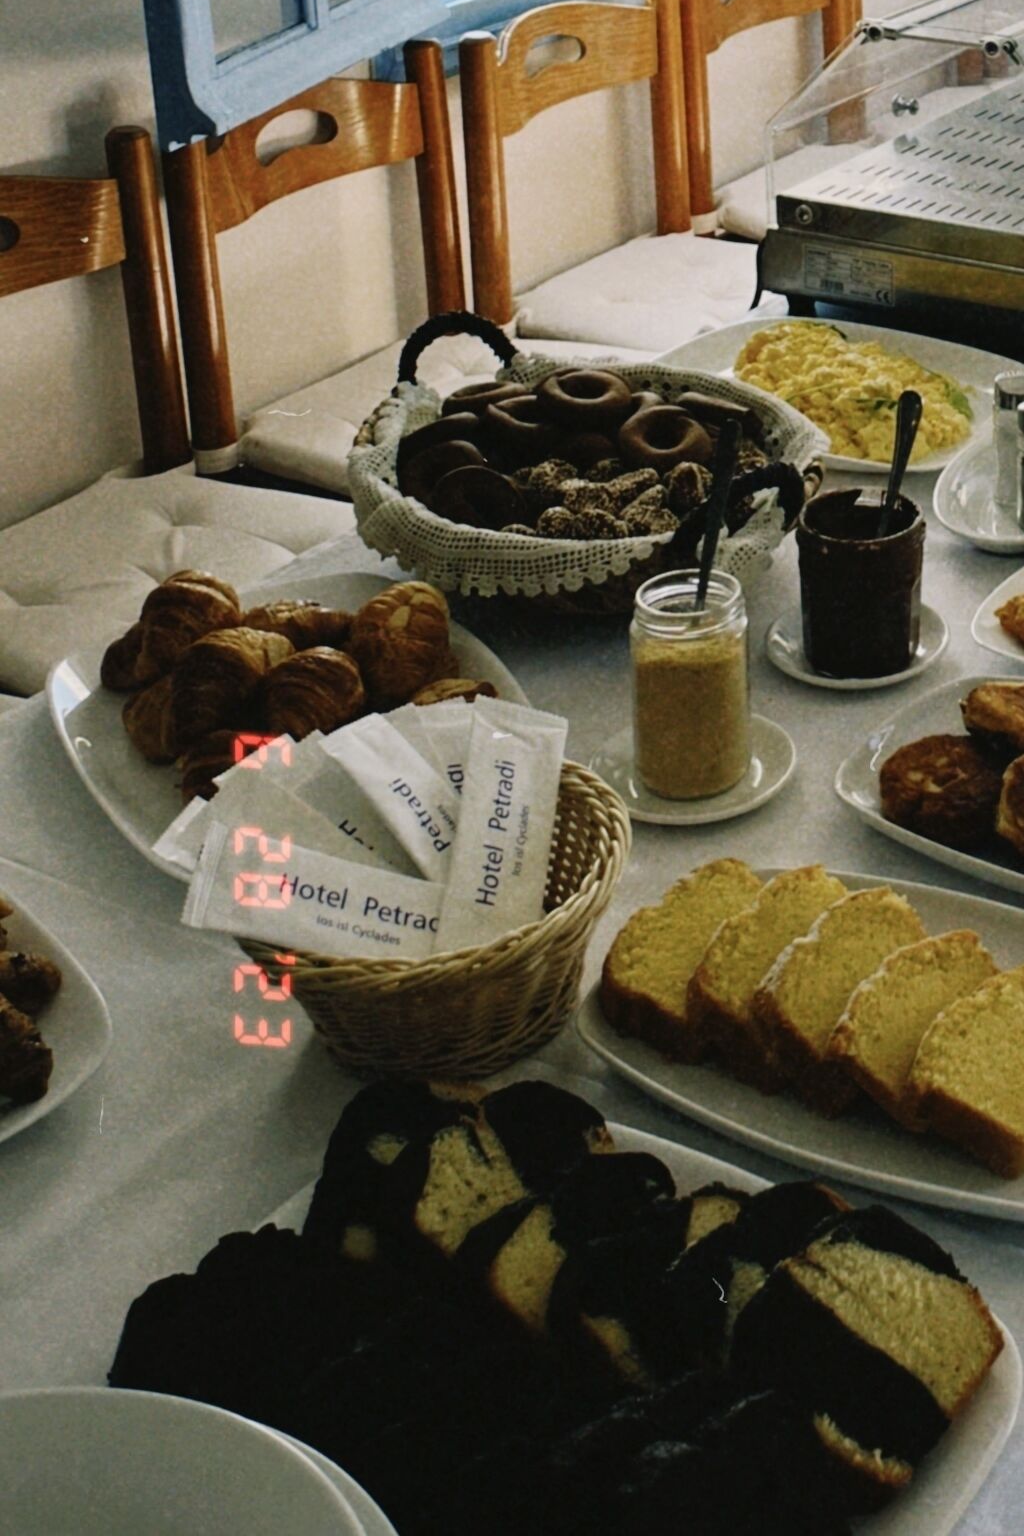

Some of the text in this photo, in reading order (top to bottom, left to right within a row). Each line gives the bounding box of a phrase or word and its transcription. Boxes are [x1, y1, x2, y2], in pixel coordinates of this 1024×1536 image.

[388, 776, 452, 853] Petradi
[475, 758, 517, 907] Hotel Petradi
[515, 804, 530, 847] Cyclades
[279, 872, 348, 910] Hotel
[351, 924, 402, 946] Cyclades
